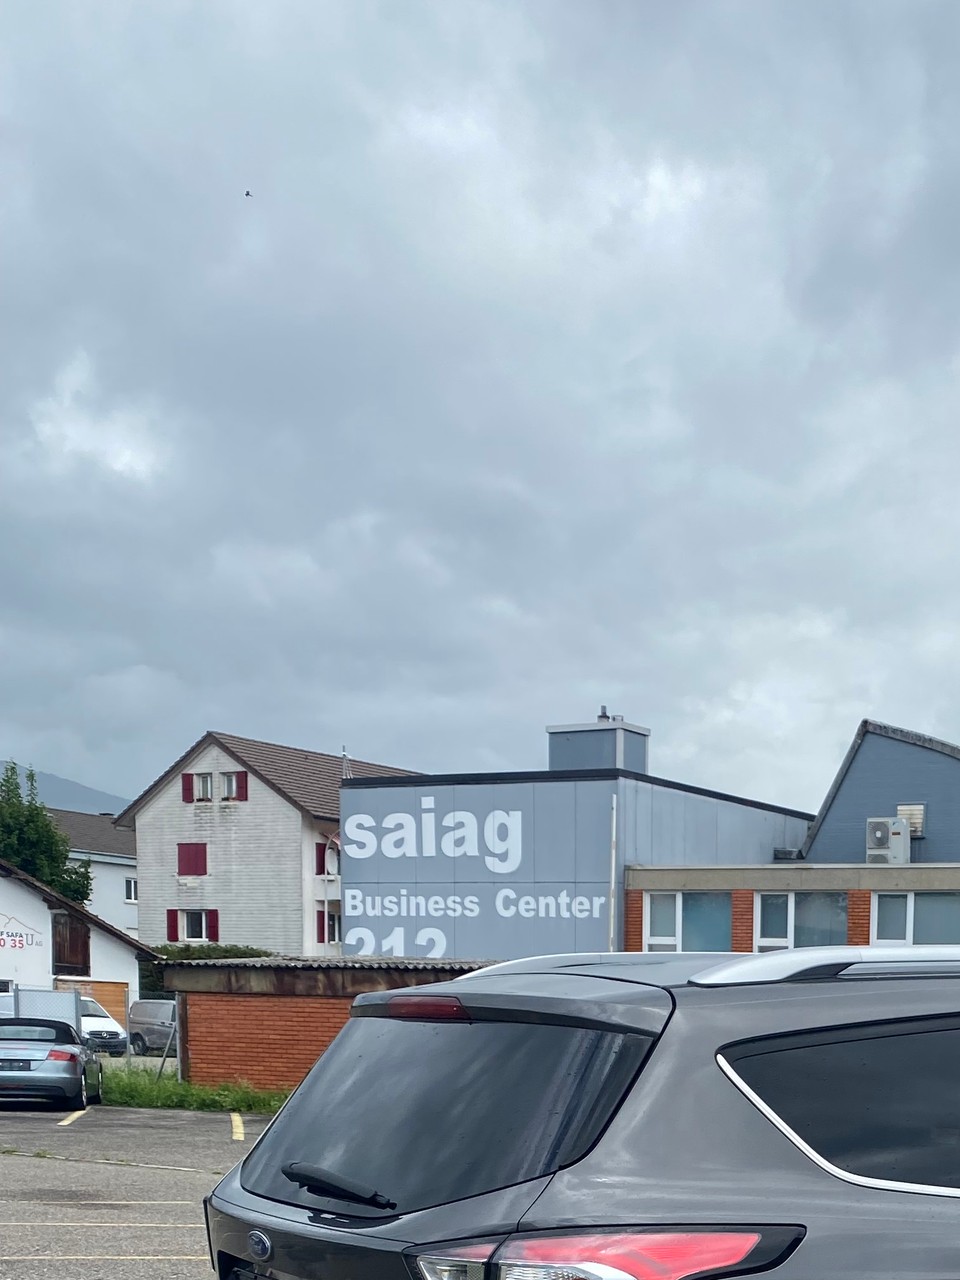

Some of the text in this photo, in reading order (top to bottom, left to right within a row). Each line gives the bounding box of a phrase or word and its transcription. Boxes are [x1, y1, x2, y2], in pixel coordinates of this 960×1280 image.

[344, 796, 522, 873] saiag
[344, 888, 605, 918] Business Center
[10, 939, 25, 949] 35
